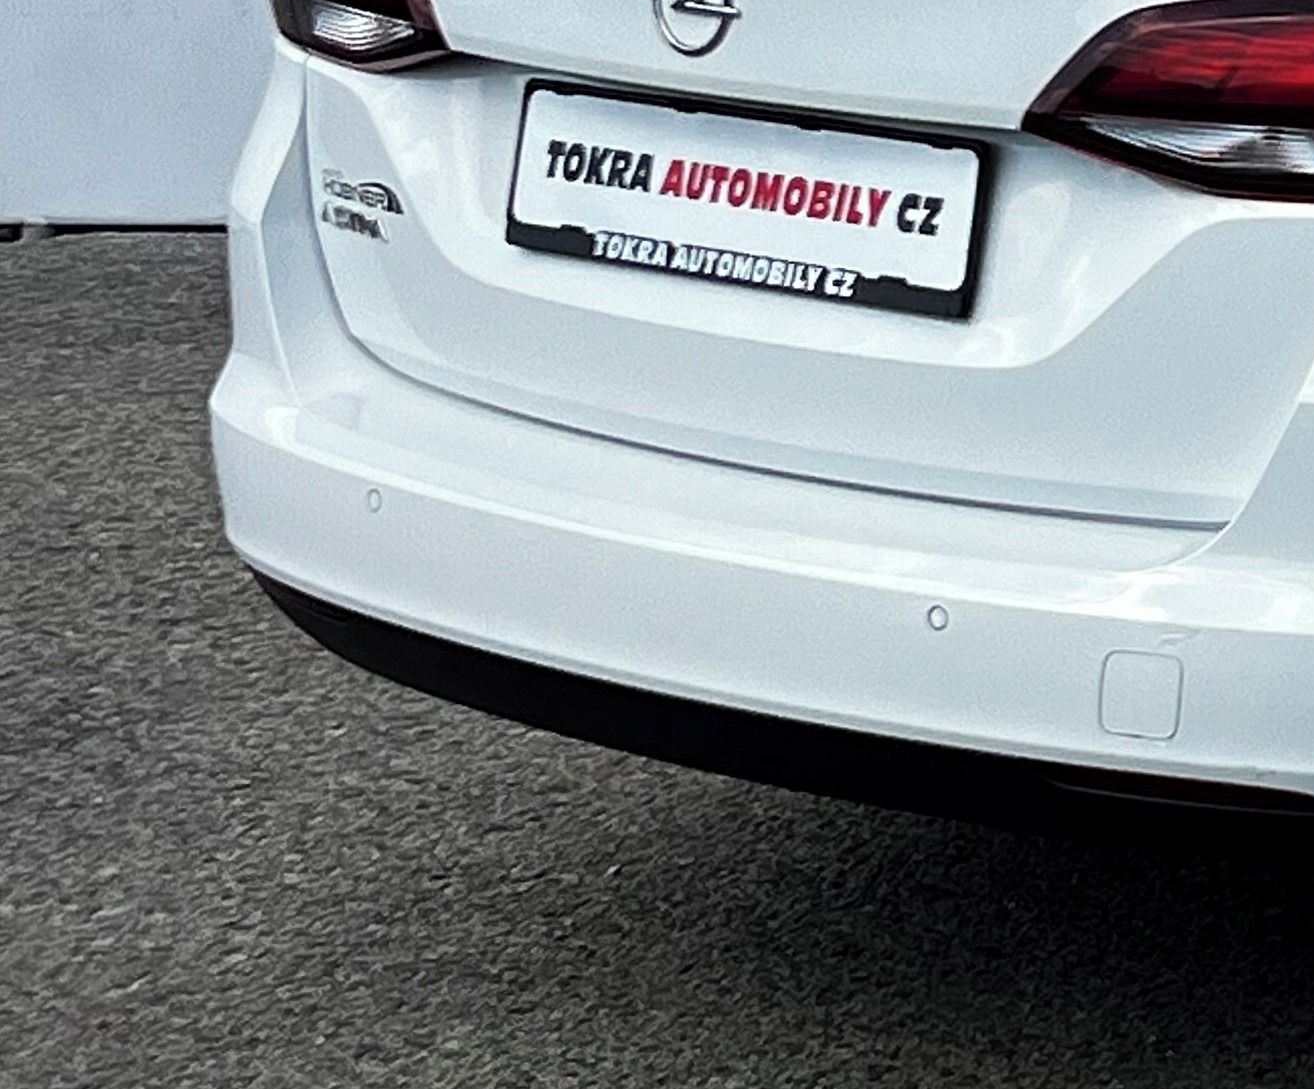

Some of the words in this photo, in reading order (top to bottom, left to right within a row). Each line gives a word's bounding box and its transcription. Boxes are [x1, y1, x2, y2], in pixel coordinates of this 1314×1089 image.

[546, 139, 654, 193] TOKRA
[660, 159, 892, 227] AUTOMOBILY
[896, 193, 944, 236] CZ
[592, 232, 668, 266] TOKRA
[670, 245, 824, 292] AUTOMOBILY
[824, 268, 859, 298] CZ
